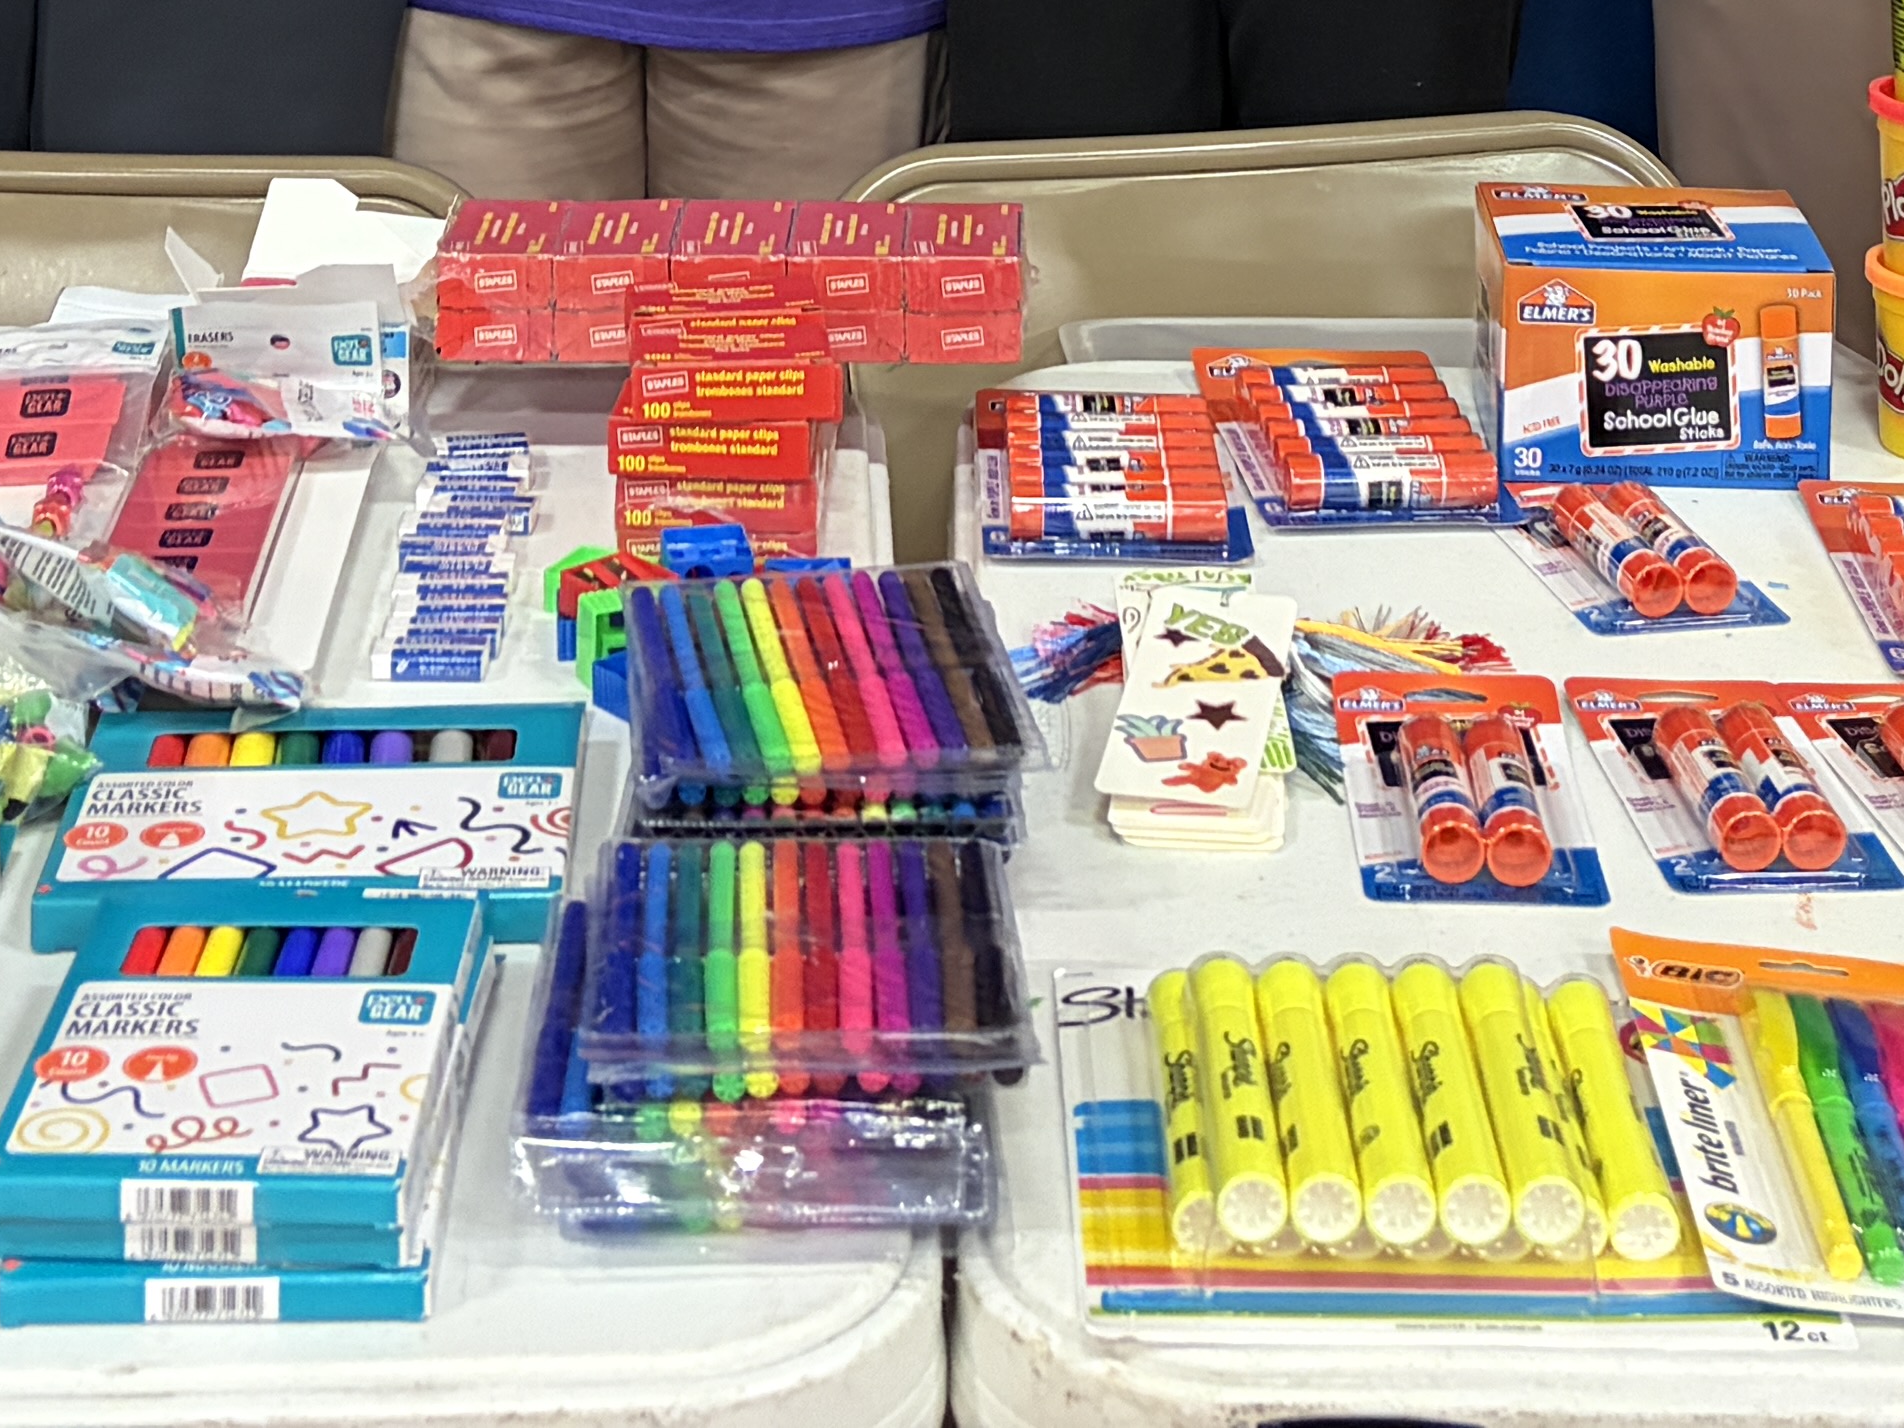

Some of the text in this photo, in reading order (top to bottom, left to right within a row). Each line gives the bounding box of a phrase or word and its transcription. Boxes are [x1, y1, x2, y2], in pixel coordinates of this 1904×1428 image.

[1498, 190, 1583, 201] ELMER'S
[1586, 204, 1633, 219] 30
[478, 275, 514, 289] STAPLES
[595, 275, 631, 290] STAPLES
[829, 278, 865, 292] STAPLES
[945, 278, 981, 294] STAPLES
[1523, 304, 1592, 322] ELMER'S
[478, 329, 514, 343] STAPLES
[829, 331, 864, 344] STAPLES
[945, 331, 980, 346] STAPLES
[337, 347, 371, 363] GEAR
[1591, 338, 1716, 383] 30 Washable
[646, 369, 805, 391] STAPLES standard paper clips
[756, 384, 805, 396] standard
[27, 400, 64, 415] GEAR
[1635, 393, 1689, 409] PURPLE
[643, 402, 671, 419] 100
[1603, 408, 1720, 431] School Glue
[622, 427, 779, 443] STAPLES standard paper clips
[1679, 427, 1725, 441] Sticks
[11, 443, 52, 457] GEAR
[730, 443, 778, 456] standard
[1514, 447, 1542, 468] 30
[618, 455, 645, 472] 100
[677, 481, 785, 495] standard paper clips
[624, 509, 652, 526] 100
[1164, 602, 1251, 645] YES
[1342, 700, 1402, 710] ELMER'S
[1581, 700, 1639, 711] ELMER'S
[1794, 701, 1851, 712] ELMER'S
[92, 787, 189, 803] CLASSIC
[507, 784, 553, 797] GEAR
[86, 800, 202, 817] MARKERS
[87, 825, 110, 837] 10
[1673, 858, 1690, 874] 2
[1661, 965, 1742, 984] BIC
[75, 1000, 183, 1019] CLASSIC
[370, 1003, 424, 1021] GEAR
[65, 1019, 200, 1037] MARKERS
[60, 1049, 90, 1067] 10
[1680, 1080, 1740, 1195] brite liner
[138, 1158, 246, 1175] 10 MARKERS
[1722, 1271, 1902, 1311] 5 ASSORTED HIGHLIGHTERS
[1763, 1320, 1831, 1344] 12 ct
